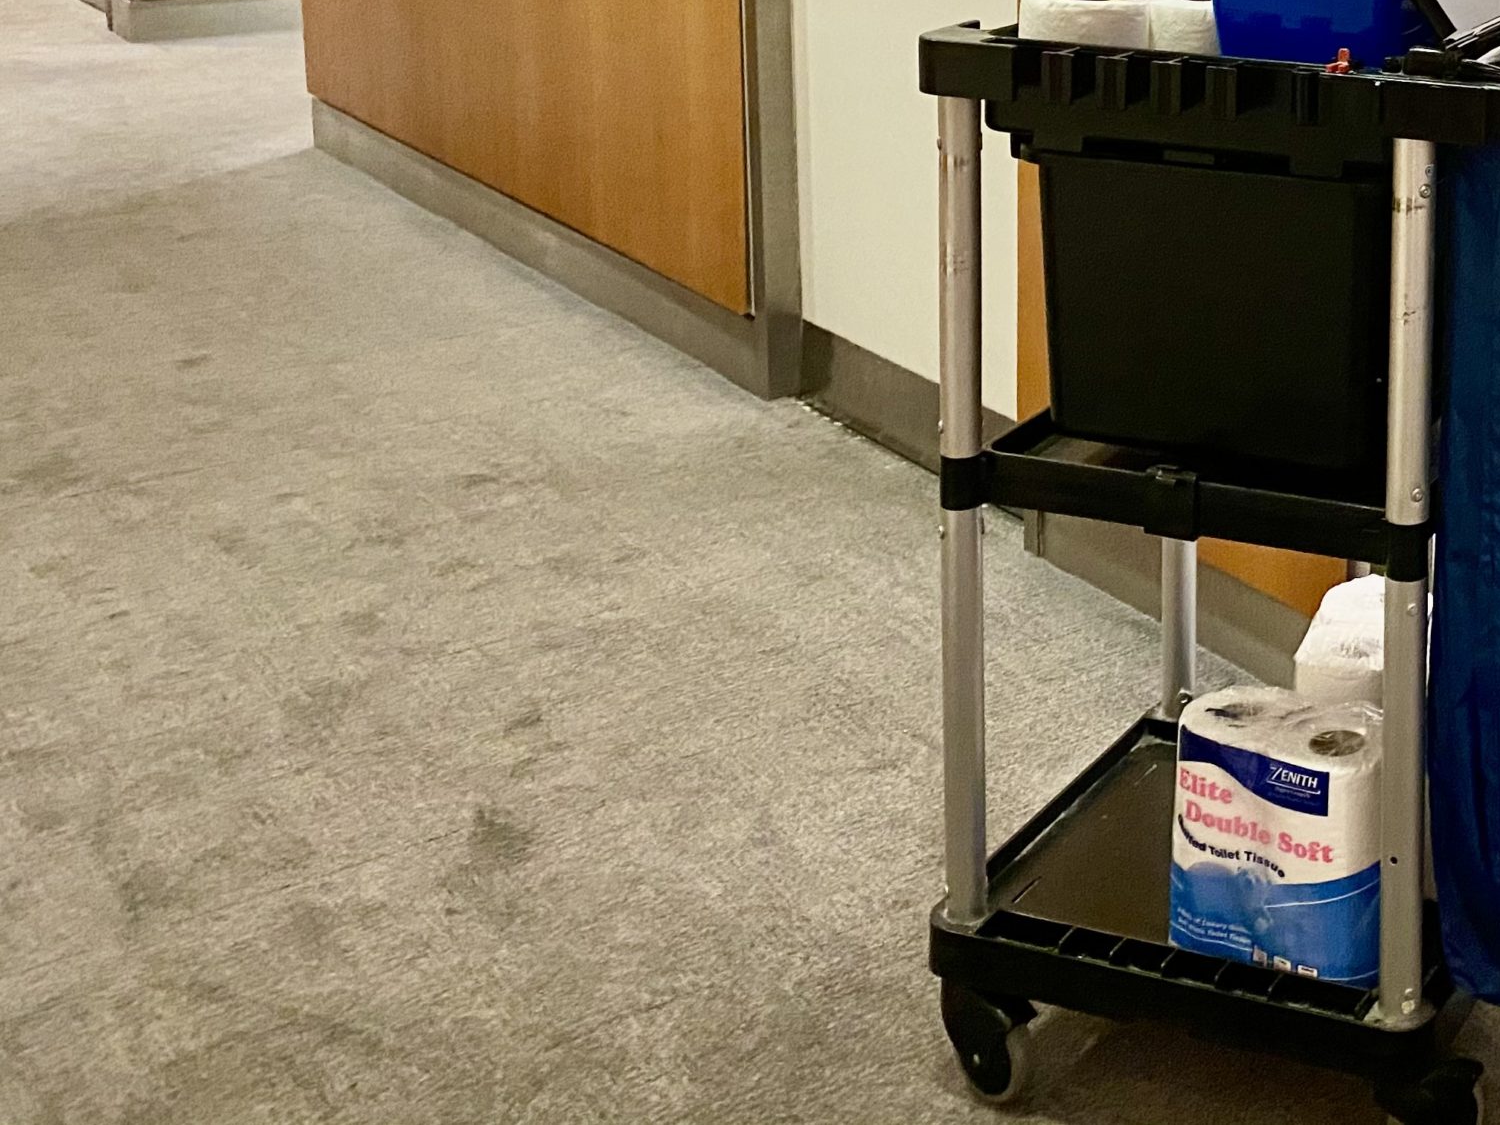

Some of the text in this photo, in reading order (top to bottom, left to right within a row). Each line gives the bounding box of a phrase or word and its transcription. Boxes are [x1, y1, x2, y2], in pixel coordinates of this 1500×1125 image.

[1180, 767, 1233, 804] Elite
[1267, 766, 1318, 789] ZENITH
[1185, 799, 1334, 863] Double Soft
[1208, 845, 1240, 861] Toilet
[1244, 850, 1285, 878] Tissue
